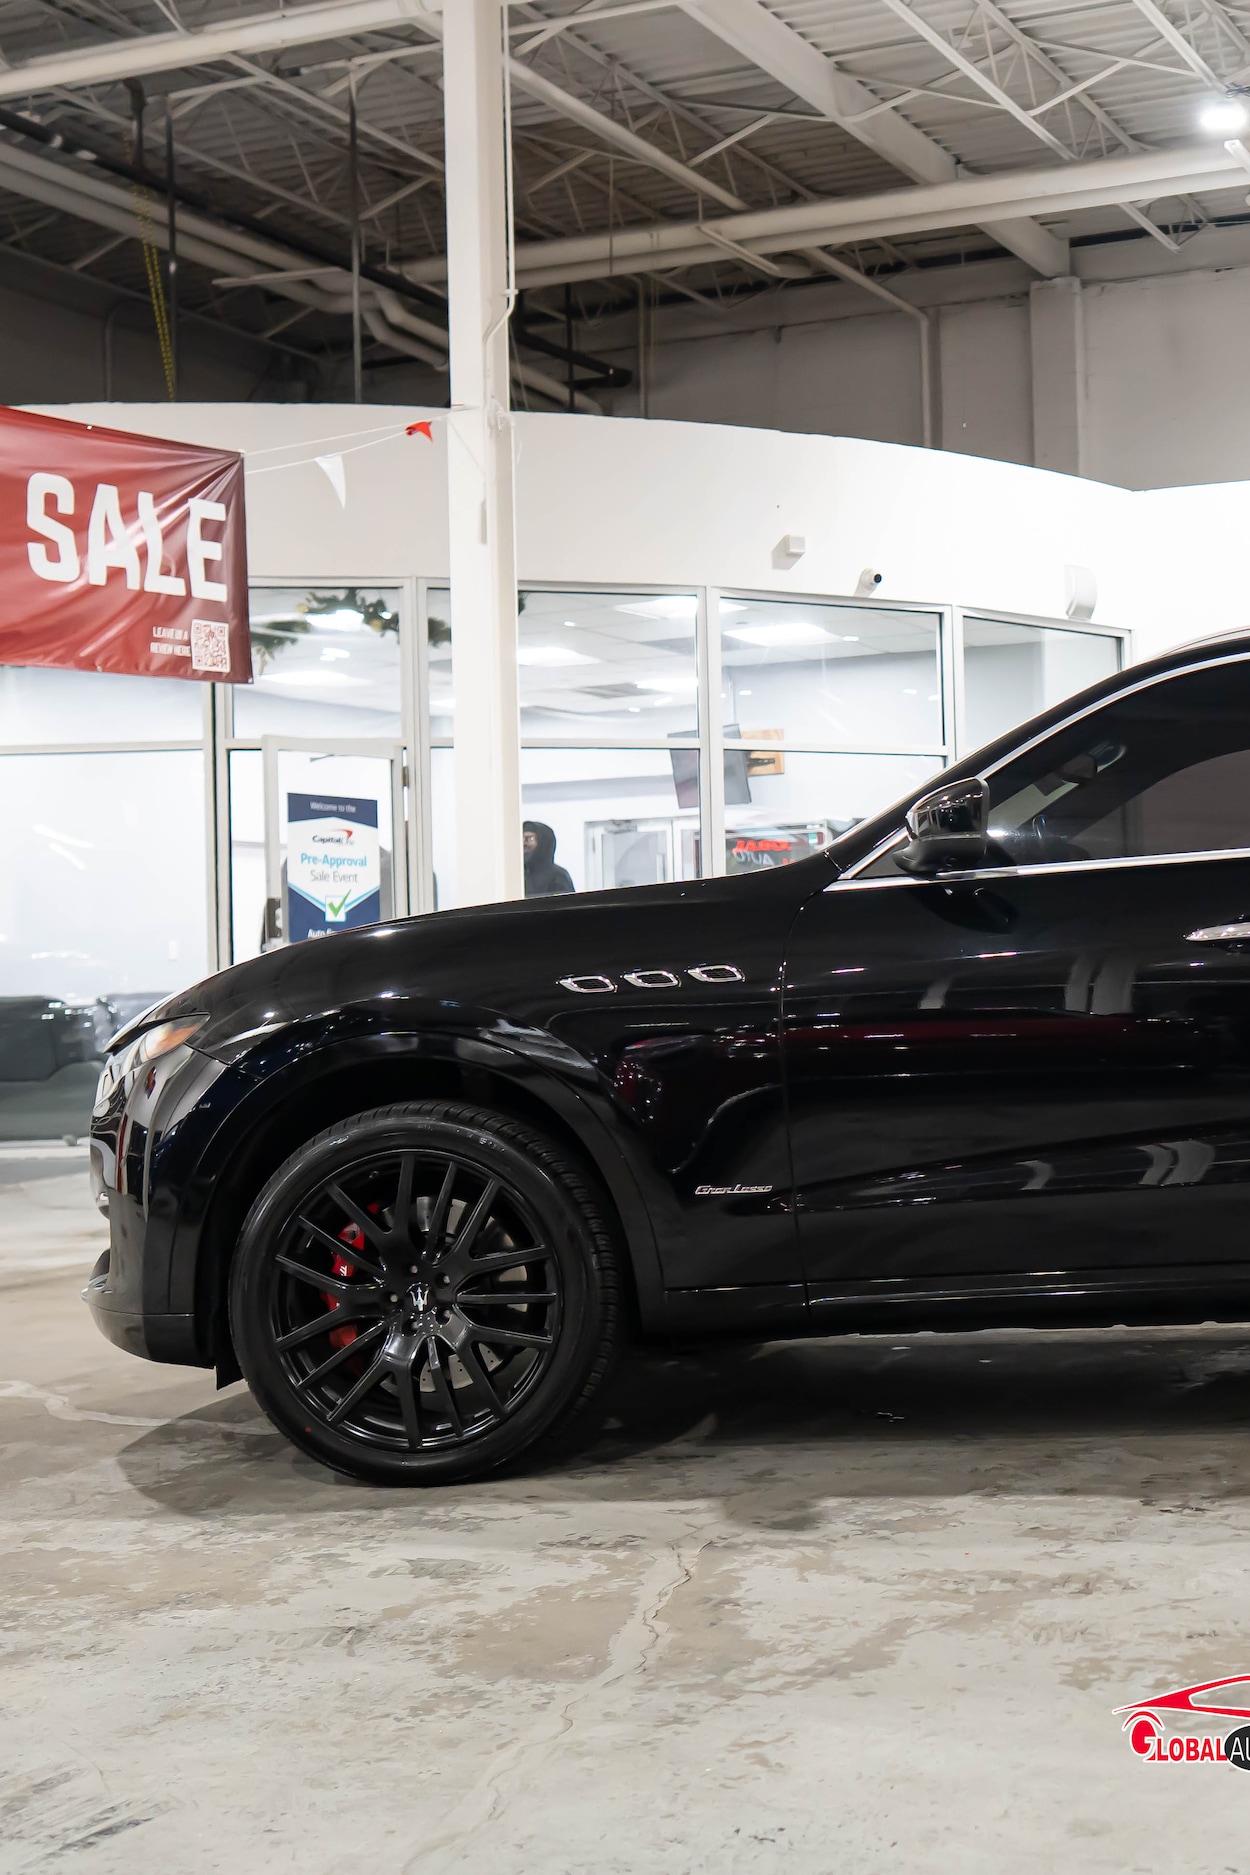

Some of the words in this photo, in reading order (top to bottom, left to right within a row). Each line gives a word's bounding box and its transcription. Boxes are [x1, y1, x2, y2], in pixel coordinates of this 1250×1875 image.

[26, 472, 228, 602] SALE
[309, 801, 337, 812] Welcome
[338, 804, 345, 812] to
[345, 804, 357, 814] the
[300, 853, 367, 868] Pre-Approval
[310, 869, 330, 882] Sale
[332, 871, 359, 883] Event
